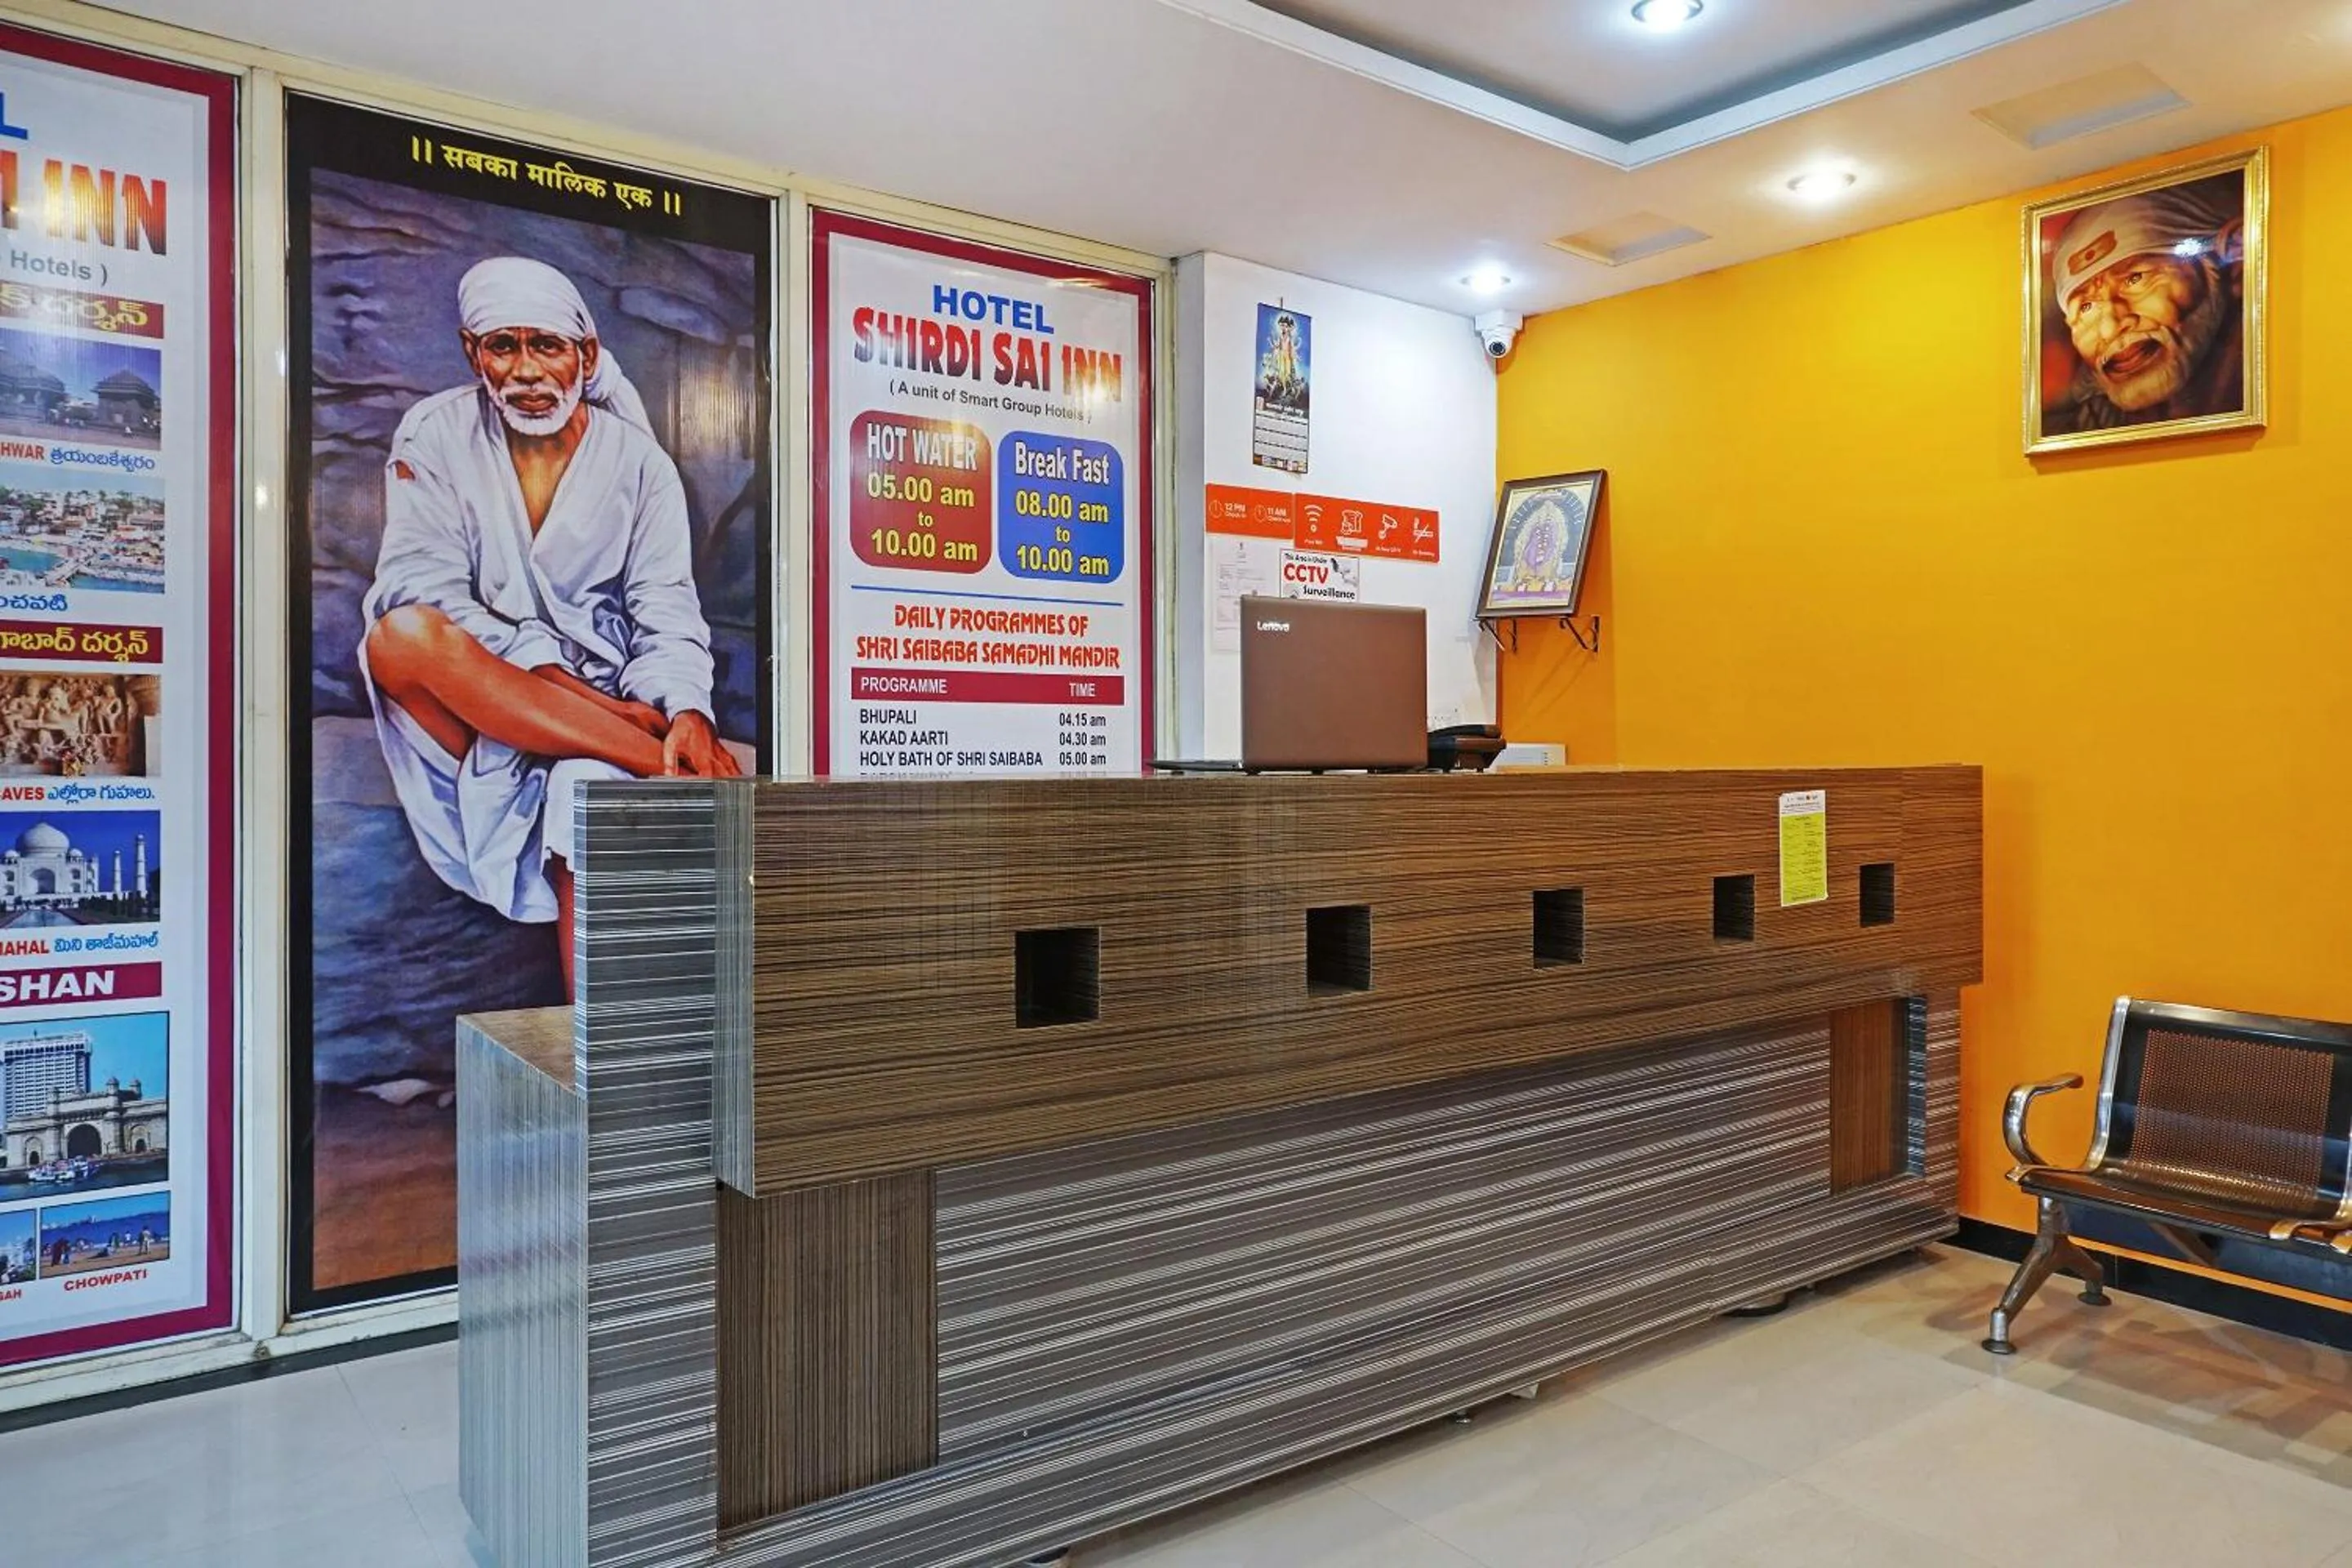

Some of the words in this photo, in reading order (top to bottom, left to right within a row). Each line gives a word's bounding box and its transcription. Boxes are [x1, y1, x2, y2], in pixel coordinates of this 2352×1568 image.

[441, 145, 518, 180] सबका
[526, 161, 607, 198] मालिक
[613, 182, 653, 210] एक
[44, 159, 167, 256] INN
[11, 250, 91, 280] Hotels
[933, 285, 1054, 334] HOTEL
[853, 307, 981, 381] SHIRDI
[993, 332, 1050, 392] SAI
[1062, 343, 1121, 402] INN
[912, 385, 938, 399] unit
[942, 389, 956, 402] of
[960, 390, 998, 408] Smart
[1002, 398, 1041, 416] Group
[1045, 403, 1084, 421] Hotels
[1, 442, 45, 461] HWAR
[867, 423, 907, 462] HOT
[913, 430, 978, 471] WATER
[1015, 441, 1067, 480] Break
[1072, 449, 1110, 486] Fast
[867, 471, 933, 503] 05.00
[940, 487, 975, 507] am
[918, 511, 933, 528] to
[1016, 490, 1072, 519] 08.00
[1079, 503, 1109, 523] am
[871, 528, 936, 558] 10.00
[944, 541, 978, 562] am
[1055, 527, 1070, 543] to
[1017, 545, 1073, 573] 10.00
[1079, 555, 1110, 576] am
[1284, 563, 1329, 584] CCTV
[1303, 585, 1356, 599] Surveillance
[894, 604, 946, 630] DAILY
[950, 610, 1065, 635] PROGRAMMES
[1069, 615, 1089, 638] OF
[1257, 621, 1290, 632] Lenovo
[82, 629, 149, 662] దర్శన్
[858, 636, 898, 662] SHRI
[903, 638, 978, 663] SAIBABA
[982, 642, 1054, 667] SAMADHI
[1059, 645, 1120, 670] MANDIR
[861, 677, 947, 694] PROGRAMME
[1069, 683, 1096, 697] TIME
[860, 710, 916, 725] BHUPALI
[1059, 713, 1088, 727] 04.15
[1089, 716, 1107, 727] am
[860, 730, 906, 746] KAKAD
[910, 731, 948, 746] AARTI
[1059, 733, 1088, 746] 04.30
[1089, 736, 1107, 746] am
[860, 751, 894, 766] HOLY
[898, 751, 933, 766] BATH
[937, 751, 954, 766] OF
[957, 752, 985, 767] SHRI
[989, 752, 1043, 767] SAIBABA
[1059, 751, 1088, 766] 05.00
[1089, 755, 1107, 766] am
[0, 786, 44, 800] AVES
[0, 970, 114, 1003] SHAN
[64, 1269, 148, 1291] CHOWPATI
